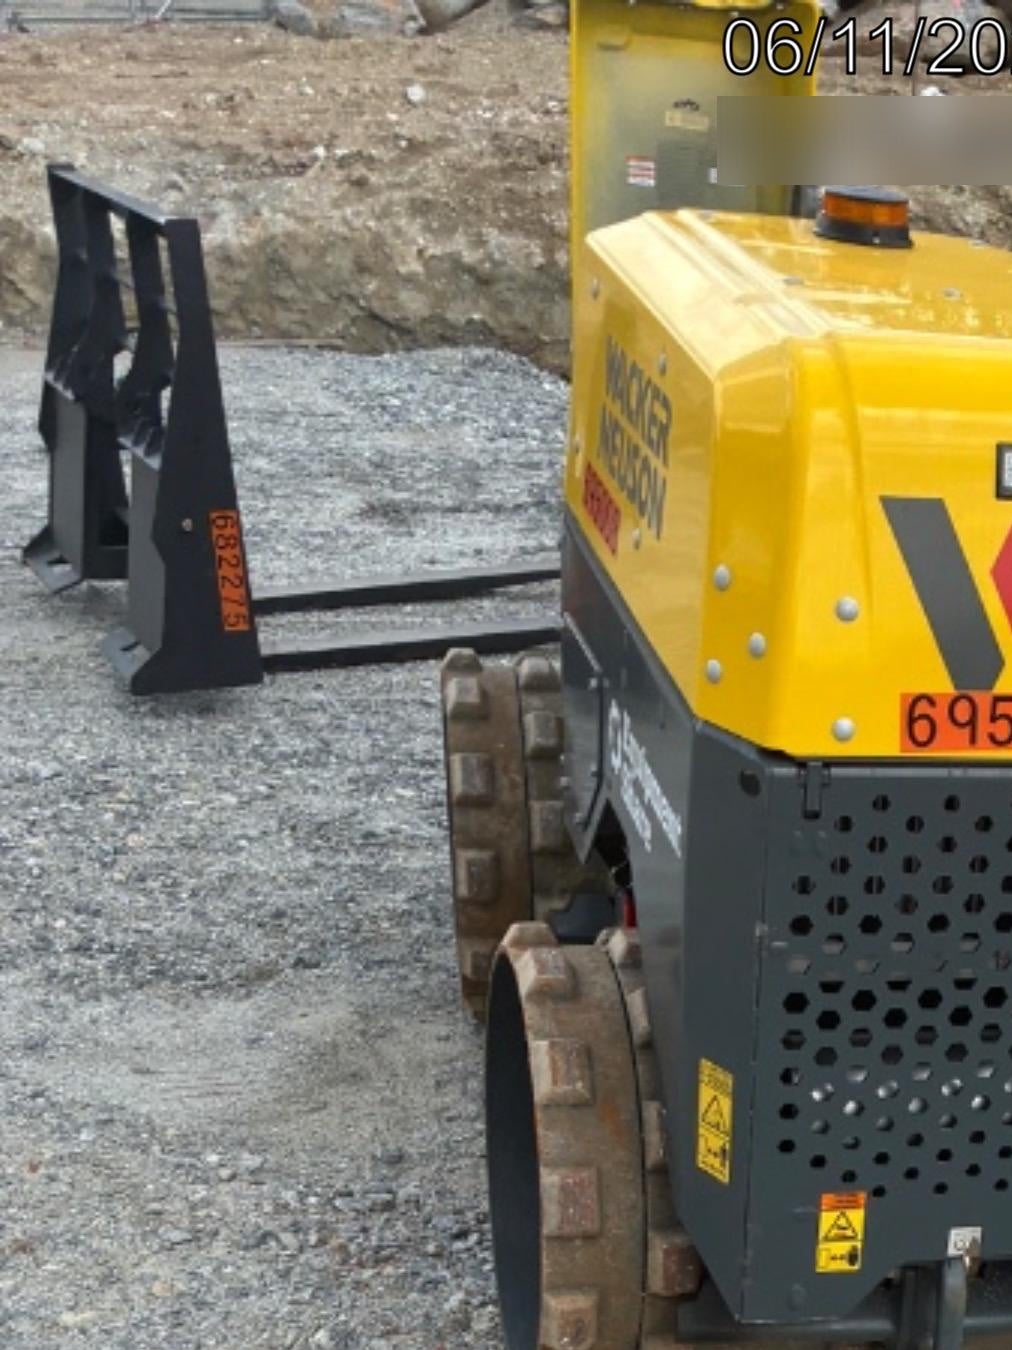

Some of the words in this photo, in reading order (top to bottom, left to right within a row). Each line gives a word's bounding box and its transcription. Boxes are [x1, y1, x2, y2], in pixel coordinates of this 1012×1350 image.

[604, 334, 673, 469] WACKER
[598, 402, 668, 542] NEUSON
[213, 513, 248, 628] 682275
